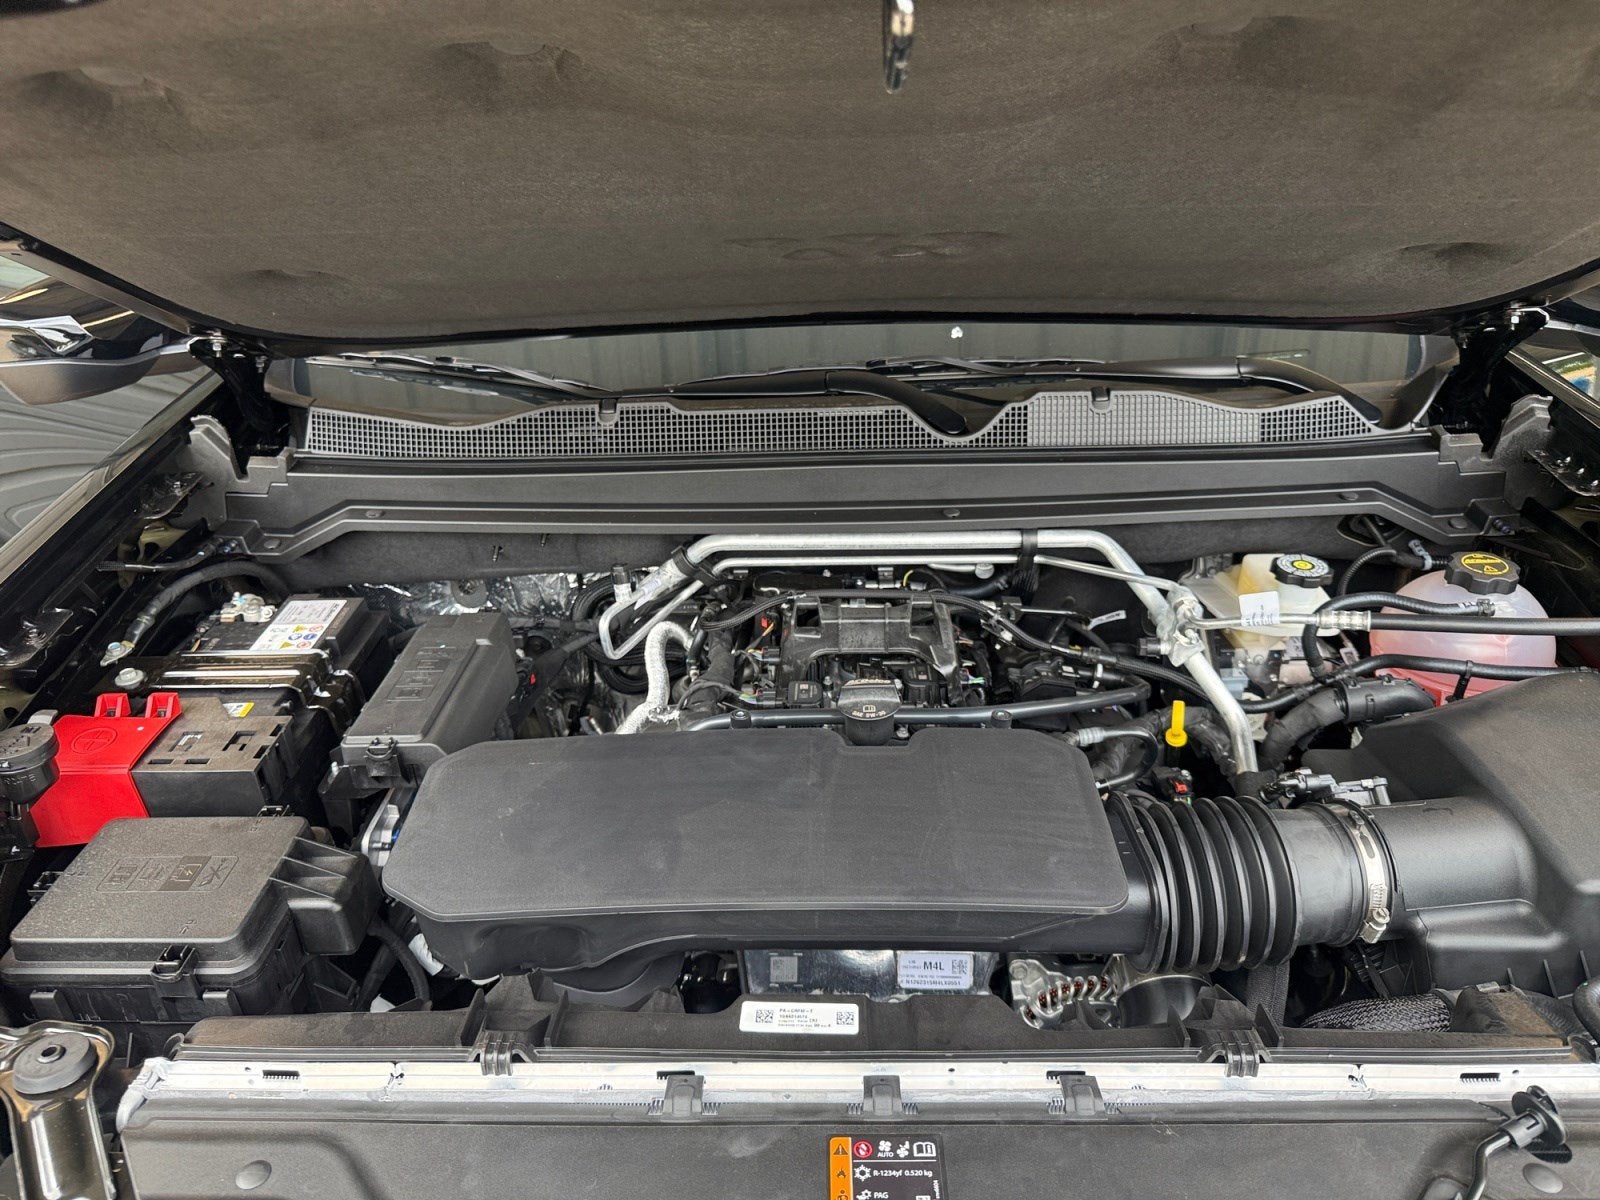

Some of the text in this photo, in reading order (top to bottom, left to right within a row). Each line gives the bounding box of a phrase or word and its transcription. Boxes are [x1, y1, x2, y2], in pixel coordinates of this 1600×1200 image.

[923, 961, 945, 971] M4L
[873, 1169, 902, 1178] R-1234yf
[924, 1169, 933, 1178] kg
[873, 1191, 889, 1199] PAG
